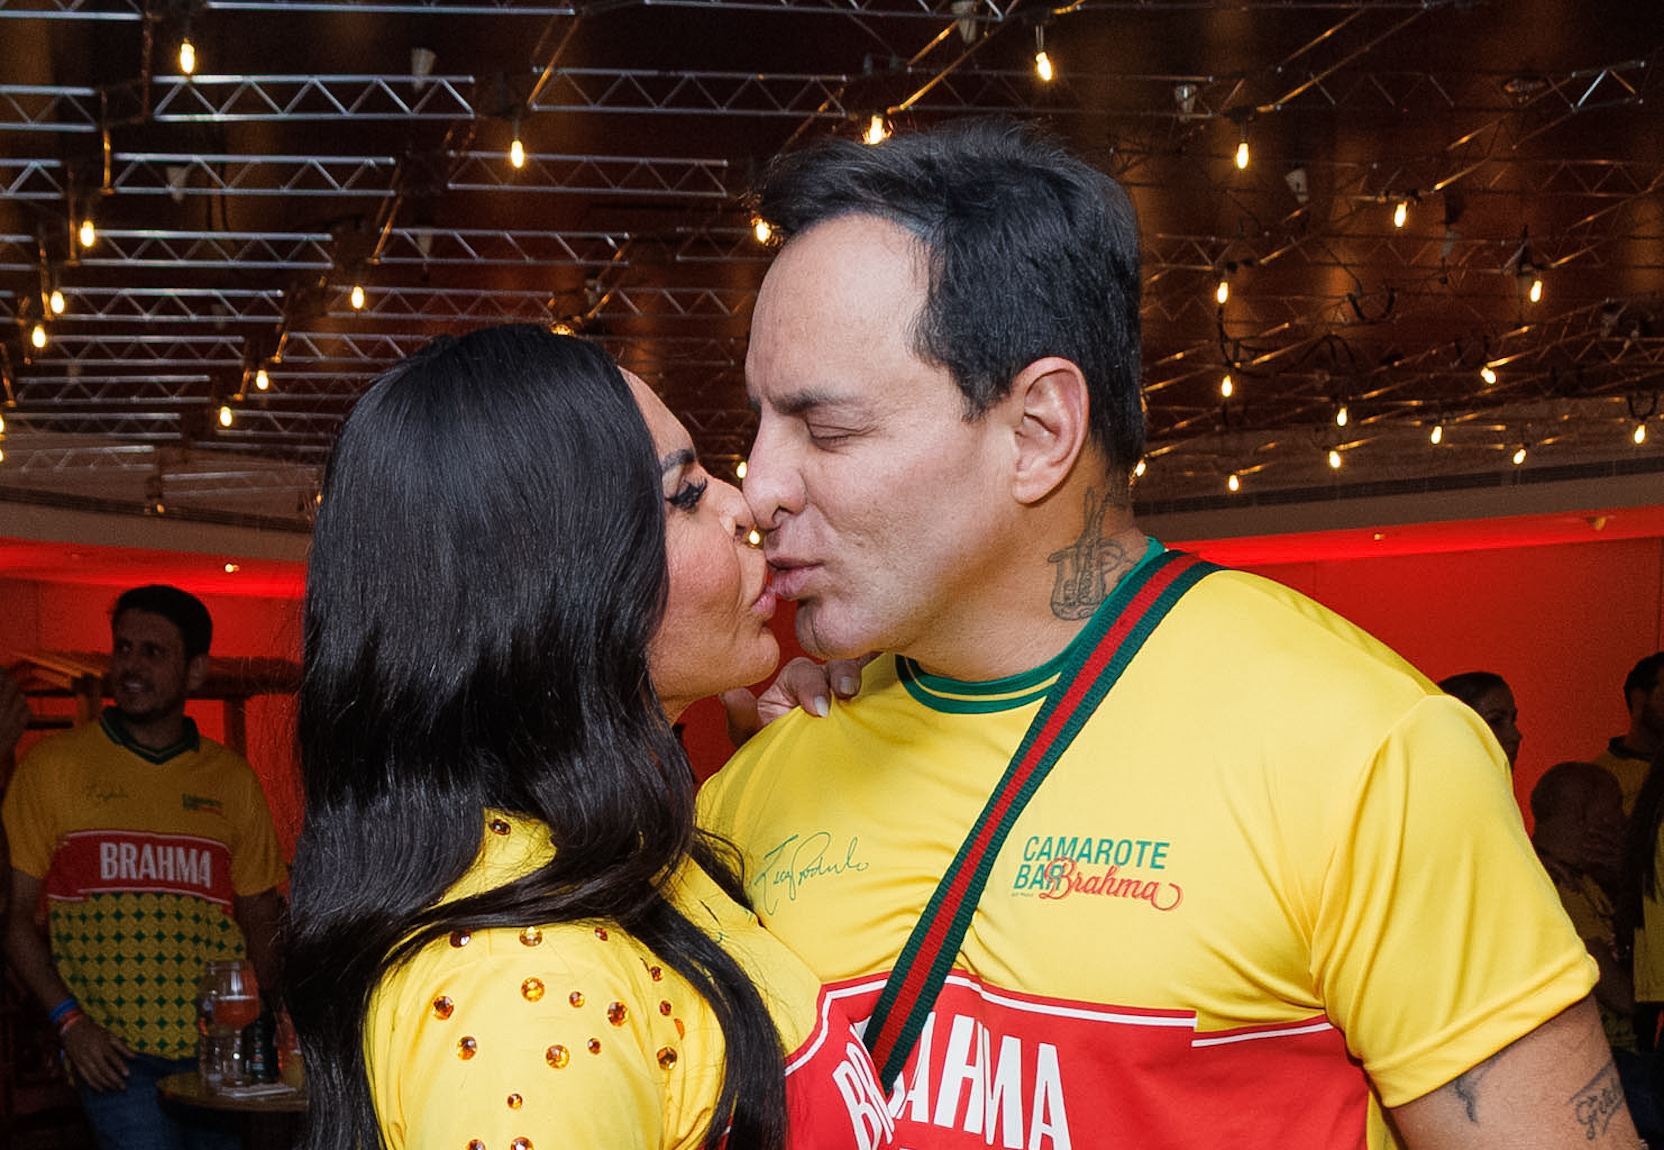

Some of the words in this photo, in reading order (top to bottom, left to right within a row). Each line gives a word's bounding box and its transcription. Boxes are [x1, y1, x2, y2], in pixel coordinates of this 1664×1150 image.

[100, 842, 211, 889] BRAHMA
[1023, 836, 1170, 869] CAMAROTE
[1013, 864, 1065, 891] BAR
[1039, 857, 1184, 911] Brahma
